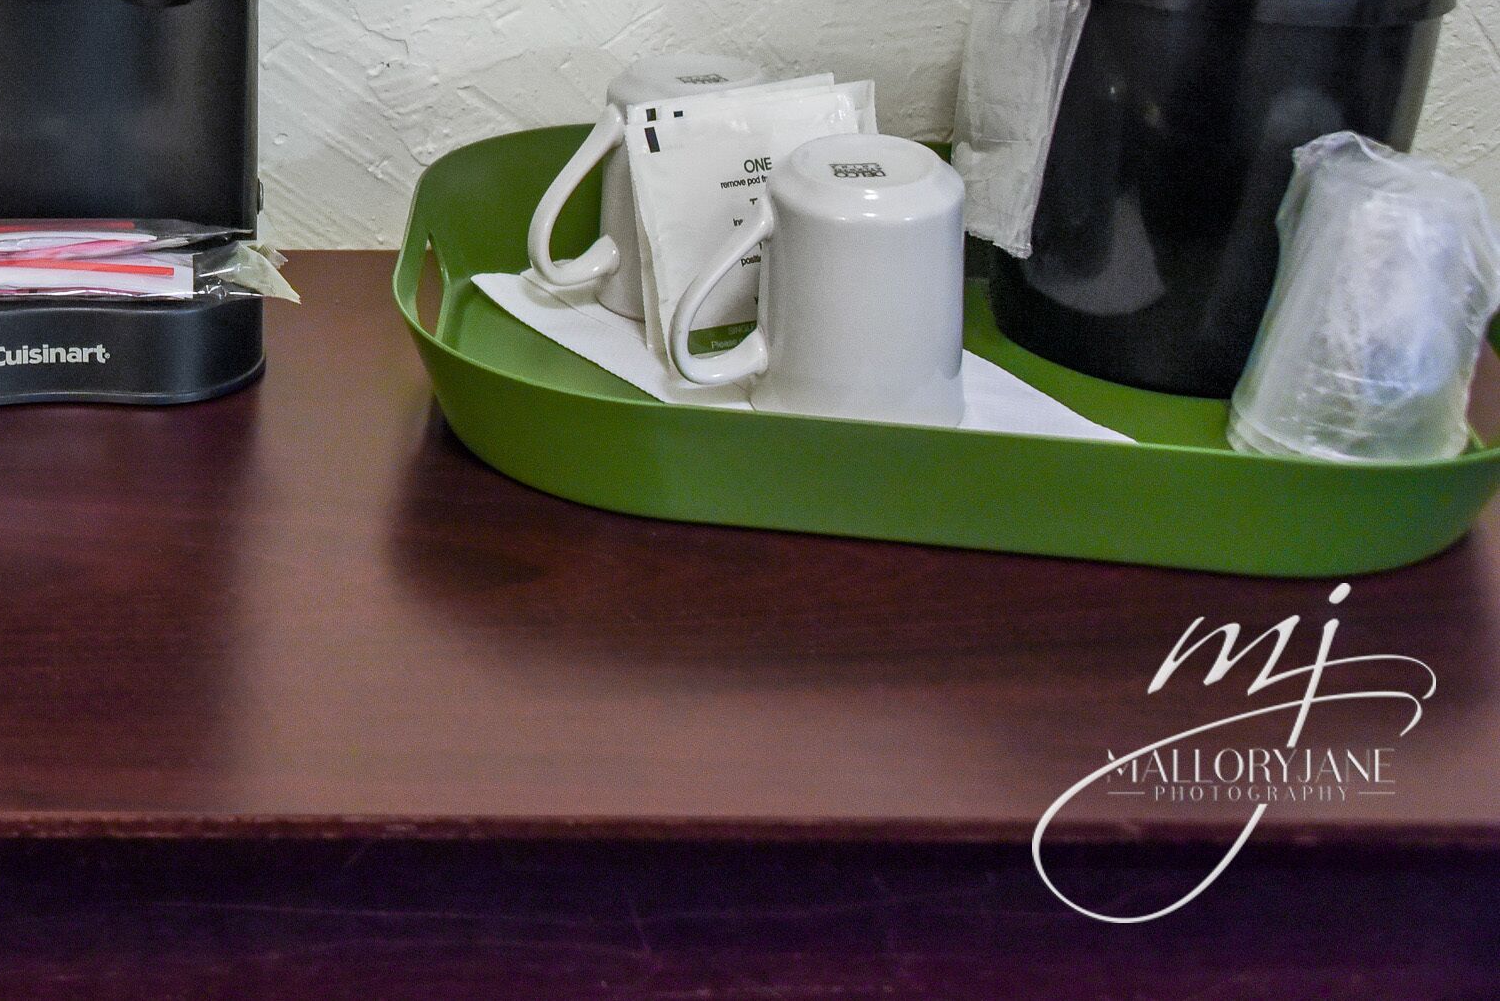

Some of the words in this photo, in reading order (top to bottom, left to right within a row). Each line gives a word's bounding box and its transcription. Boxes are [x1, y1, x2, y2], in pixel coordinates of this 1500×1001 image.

[744, 156, 773, 174] ONE
[720, 179, 746, 189] remove
[747, 176, 760, 186] pod
